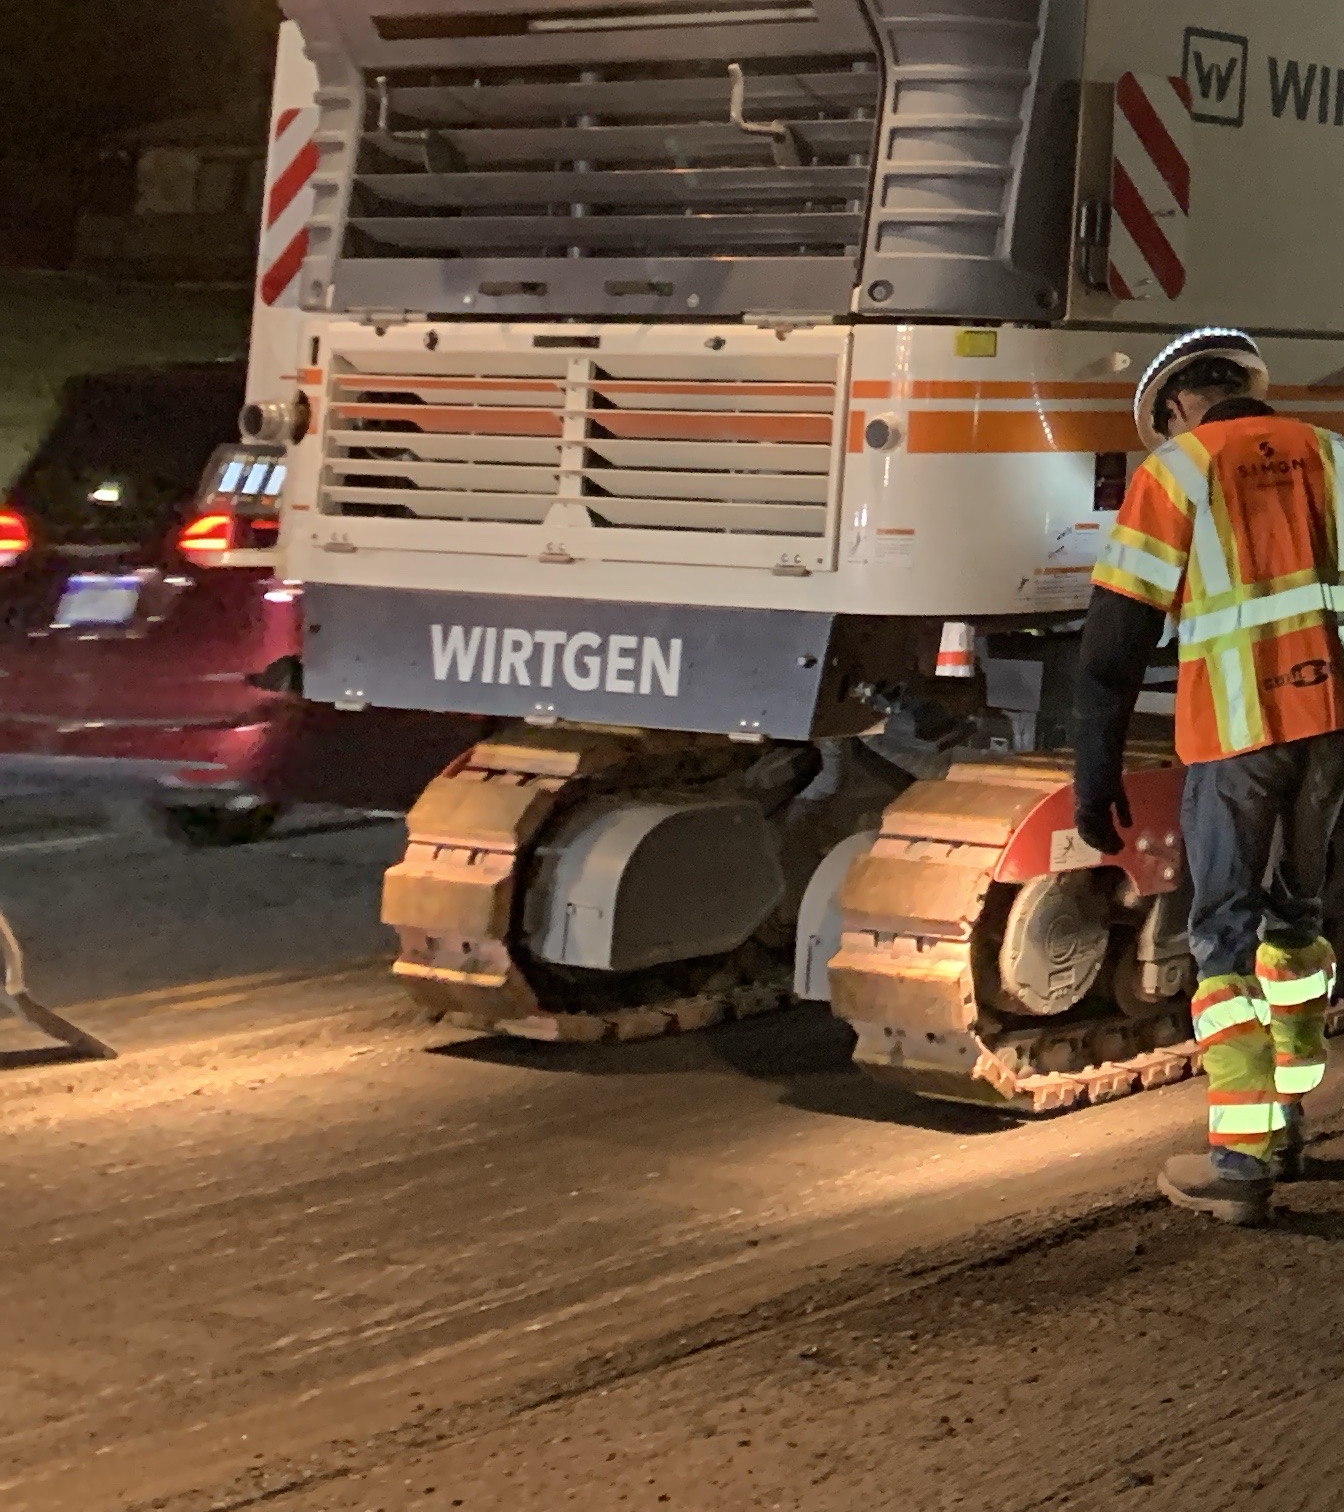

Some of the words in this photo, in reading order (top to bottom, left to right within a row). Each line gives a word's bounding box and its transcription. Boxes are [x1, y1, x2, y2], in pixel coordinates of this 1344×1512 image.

[1193, 51, 1238, 103] W
[1238, 457, 1307, 478] SIMON
[430, 623, 683, 697] WIRTGEN
